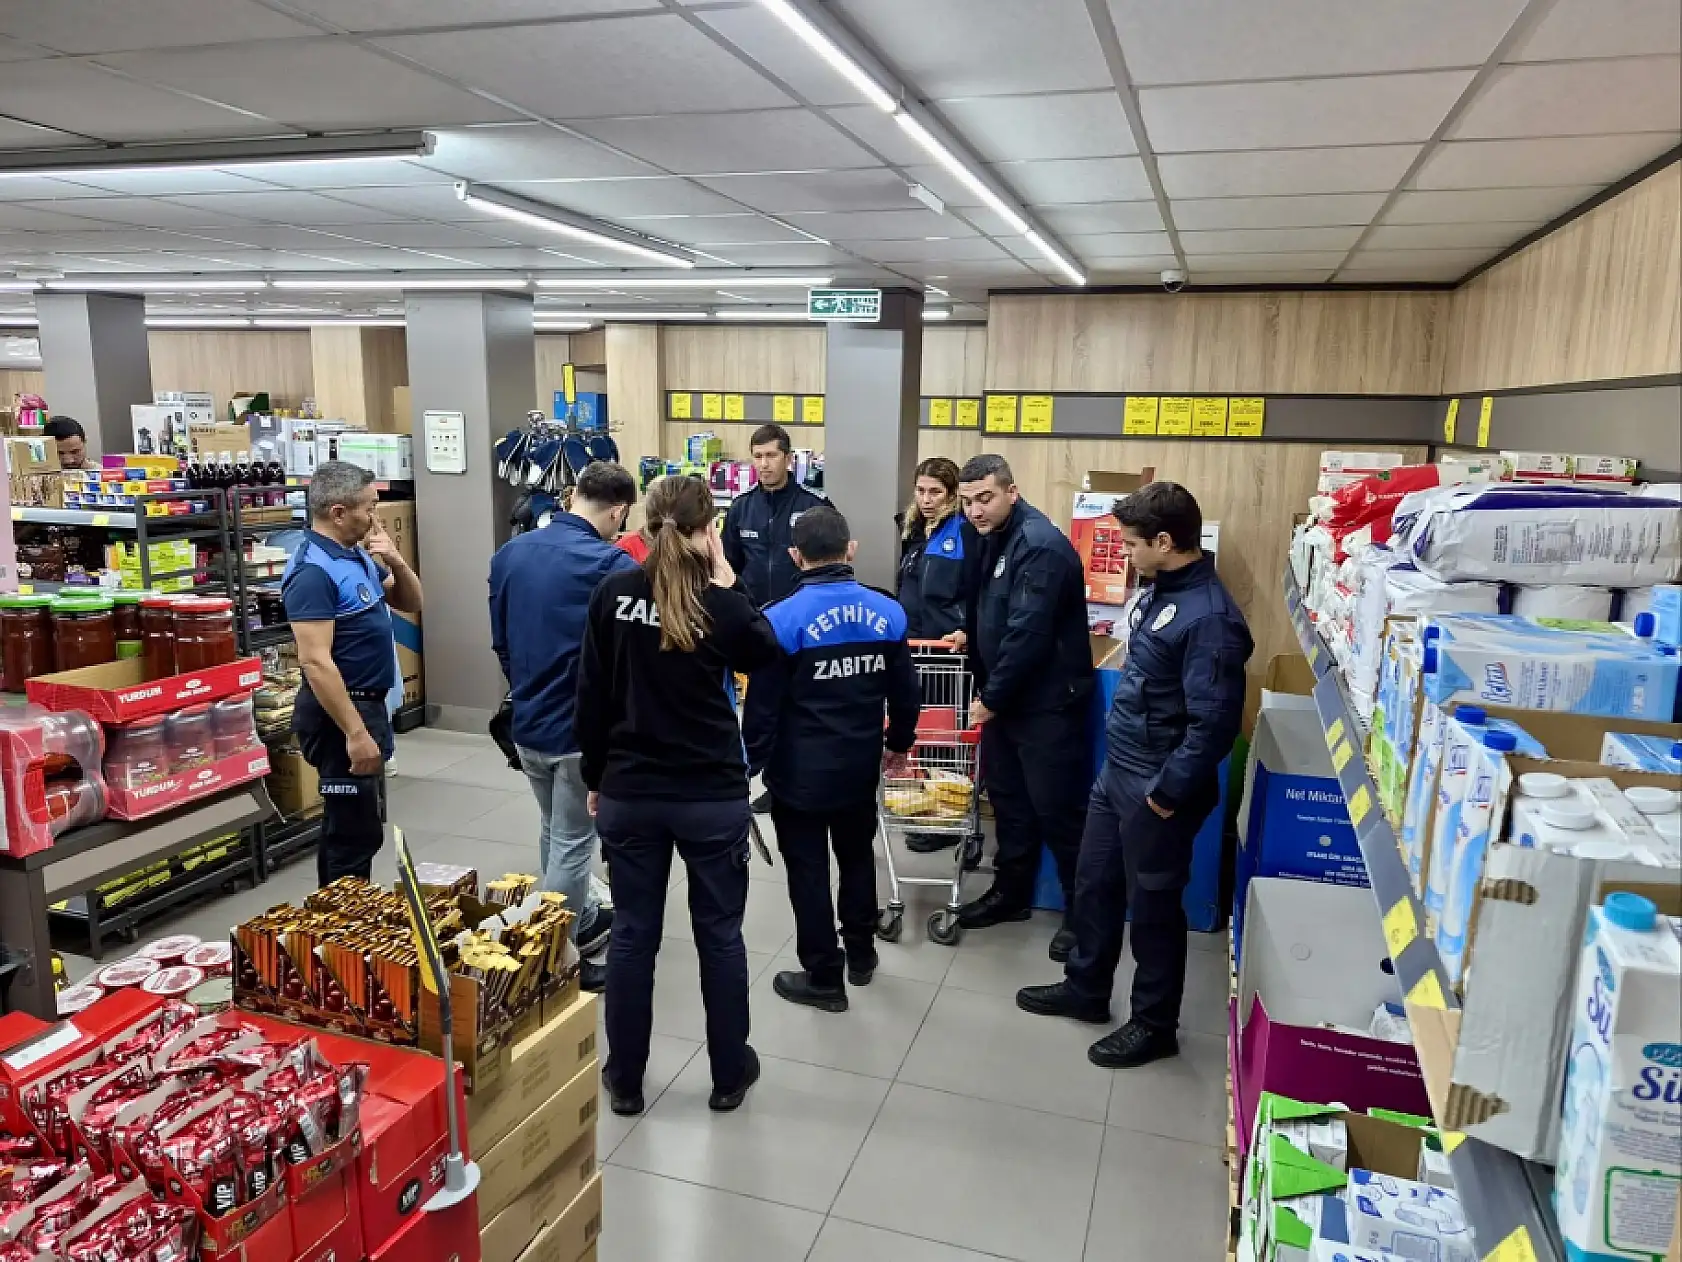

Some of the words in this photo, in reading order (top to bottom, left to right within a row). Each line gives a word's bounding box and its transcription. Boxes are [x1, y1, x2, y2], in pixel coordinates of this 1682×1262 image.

[805, 601, 888, 641] FETHİYE
[812, 654, 886, 680] ZABITA
[118, 686, 162, 703] YURDUM
[133, 779, 175, 799] YURDUM
[320, 785, 358, 794] ZABITA
[216, 1183, 234, 1210] VIP
